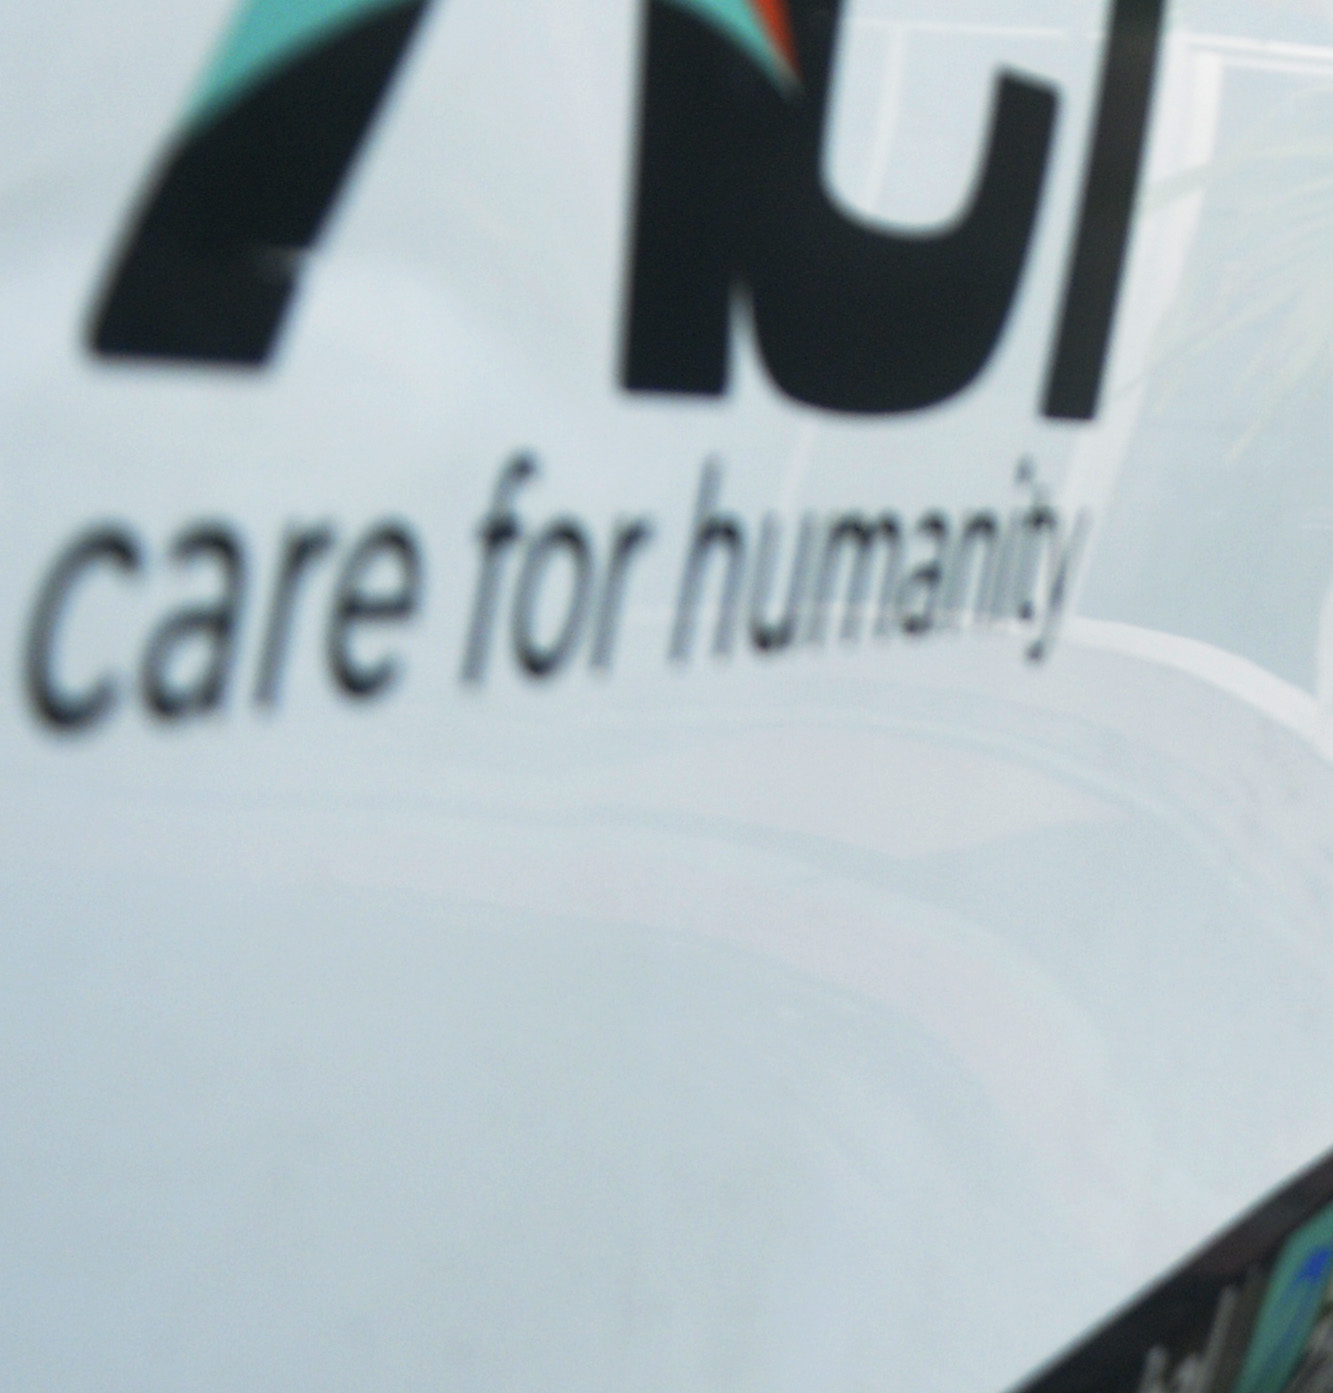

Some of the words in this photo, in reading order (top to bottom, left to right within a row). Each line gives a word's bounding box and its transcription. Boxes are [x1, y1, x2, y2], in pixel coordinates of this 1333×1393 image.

[22, 514, 427, 737] care
[458, 446, 658, 692] for
[667, 451, 1089, 666] humanity
